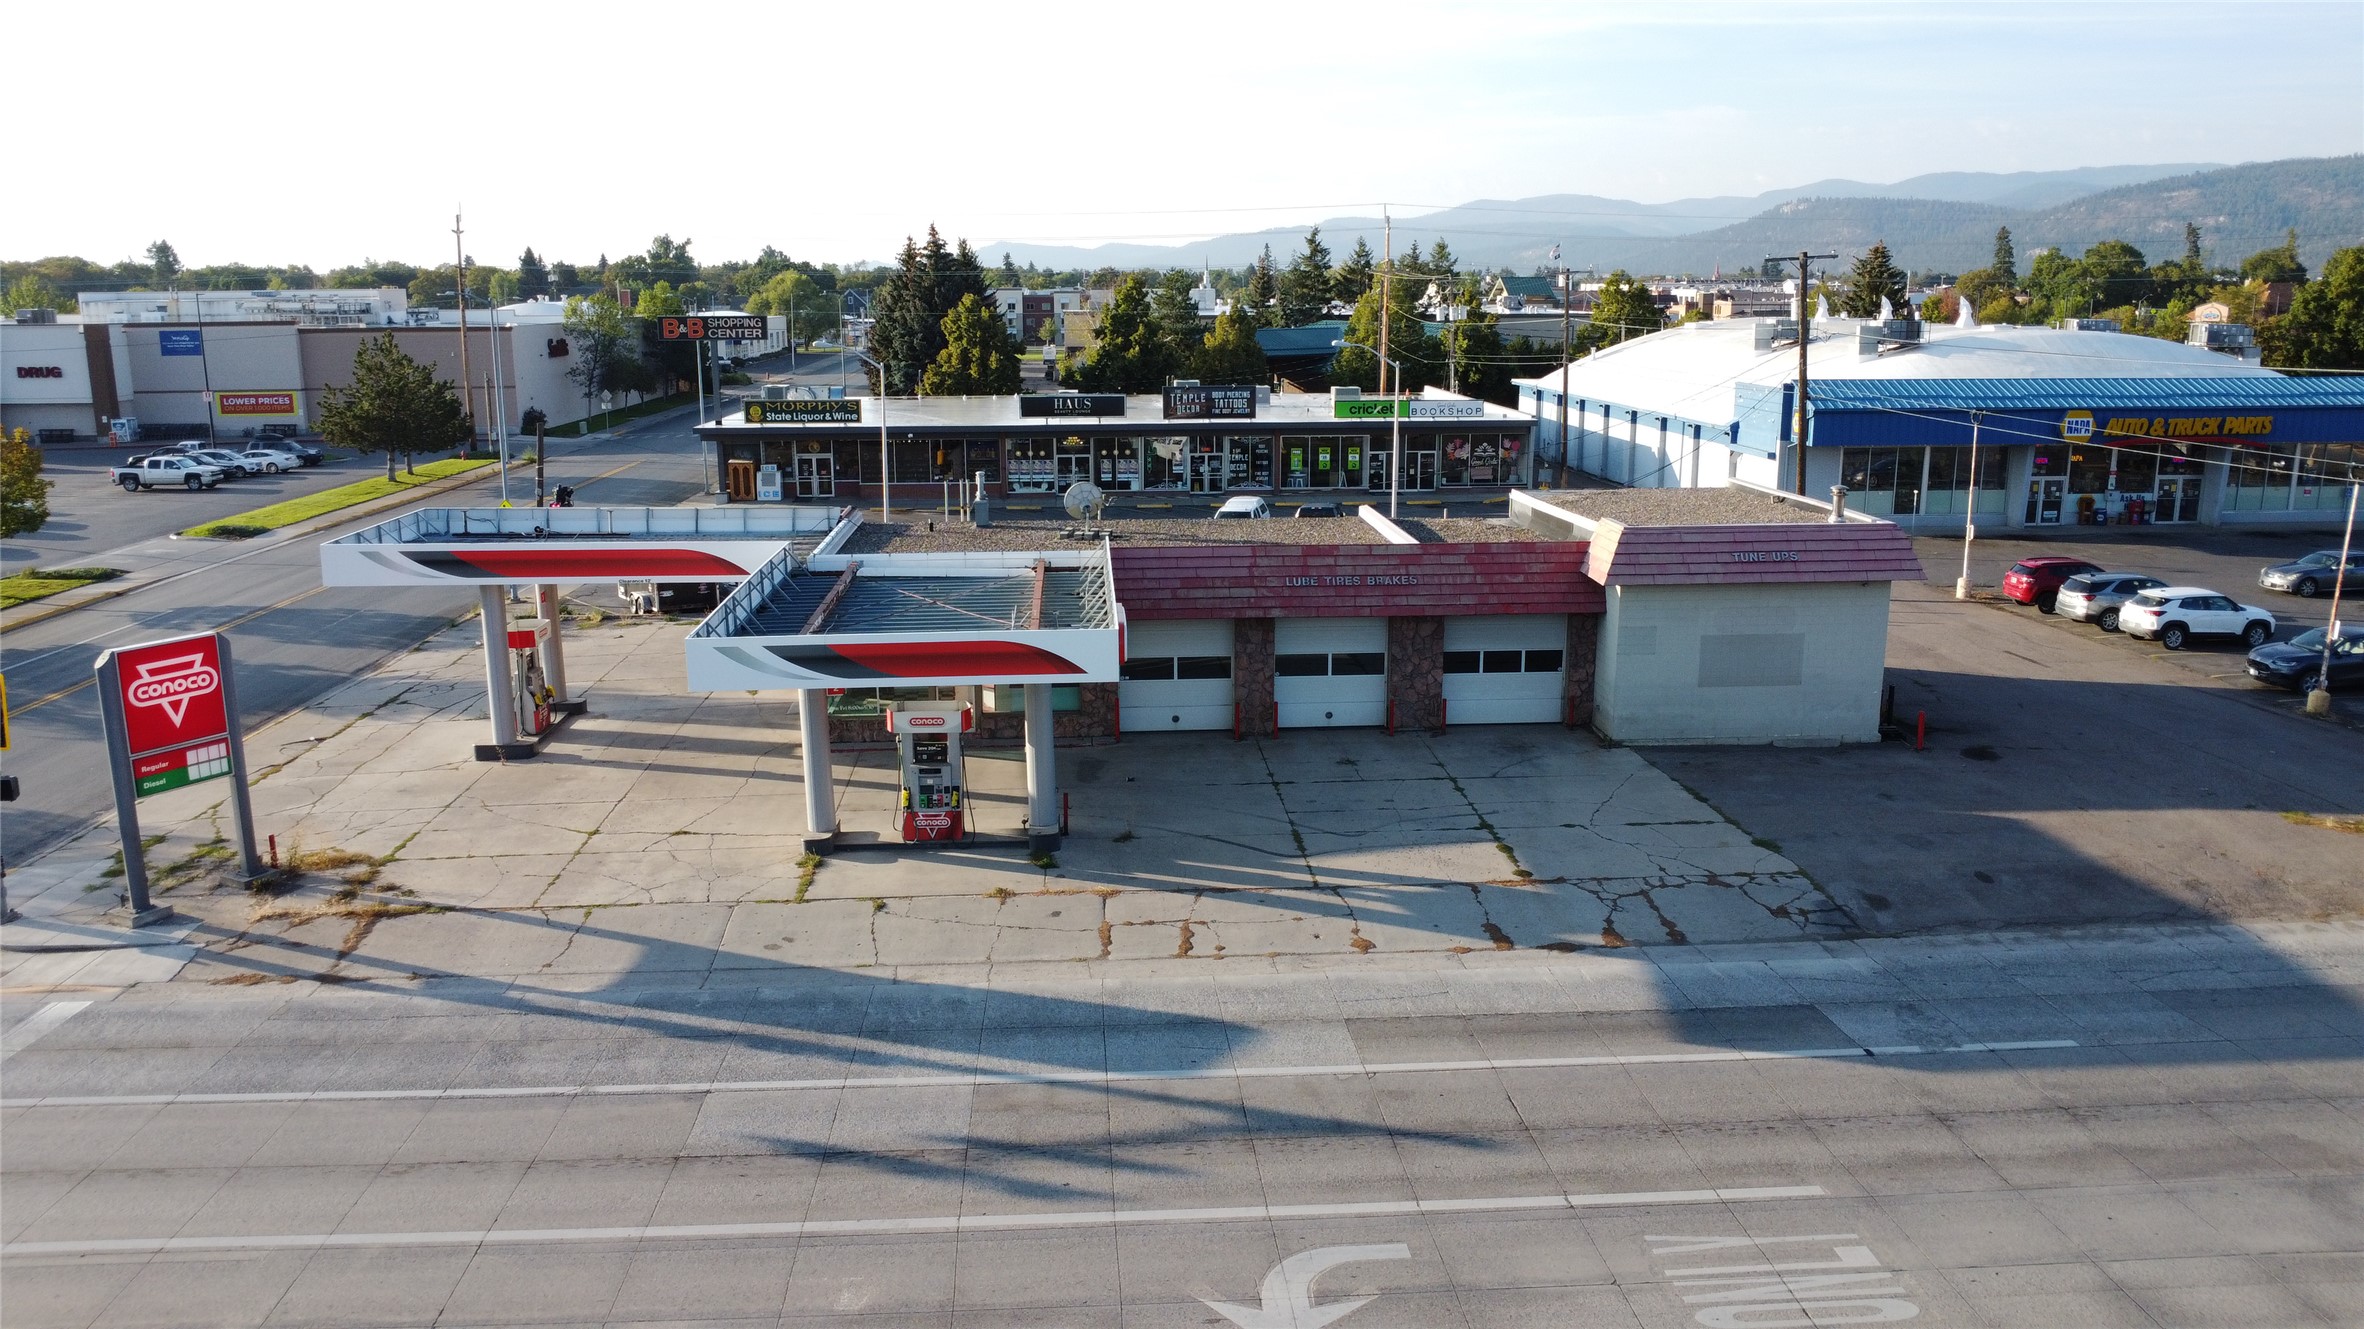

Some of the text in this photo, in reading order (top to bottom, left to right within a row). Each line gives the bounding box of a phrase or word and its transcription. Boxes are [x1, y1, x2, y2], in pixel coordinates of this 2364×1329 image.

[708, 318, 762, 328] SHOPPING
[708, 328, 762, 338] CENTER
[16, 366, 62, 378] DRUG
[224, 397, 290, 406] LOWER PRICES
[1054, 398, 1092, 409] HAUS
[1170, 394, 1206, 407] TEMPLE
[1215, 399, 1248, 408] TATTOOS
[1176, 405, 1200, 414] DECOR
[1349, 404, 1395, 415] cricket
[766, 412, 792, 420] State
[793, 412, 824, 422] Liquor
[833, 412, 858, 420] Wine
[2066, 420, 2091, 434] NAPA
[2104, 416, 2273, 436] AUTO & TRUCK PARTS
[2120, 494, 2133, 502] Ask
[1732, 552, 1798, 562] TUNE UPS
[1286, 576, 1418, 586] LUBE TIRES BRAKES
[141, 762, 169, 772] Regular
[143, 778, 166, 789] Diesel
[1644, 1233, 1920, 1329] ONLY
